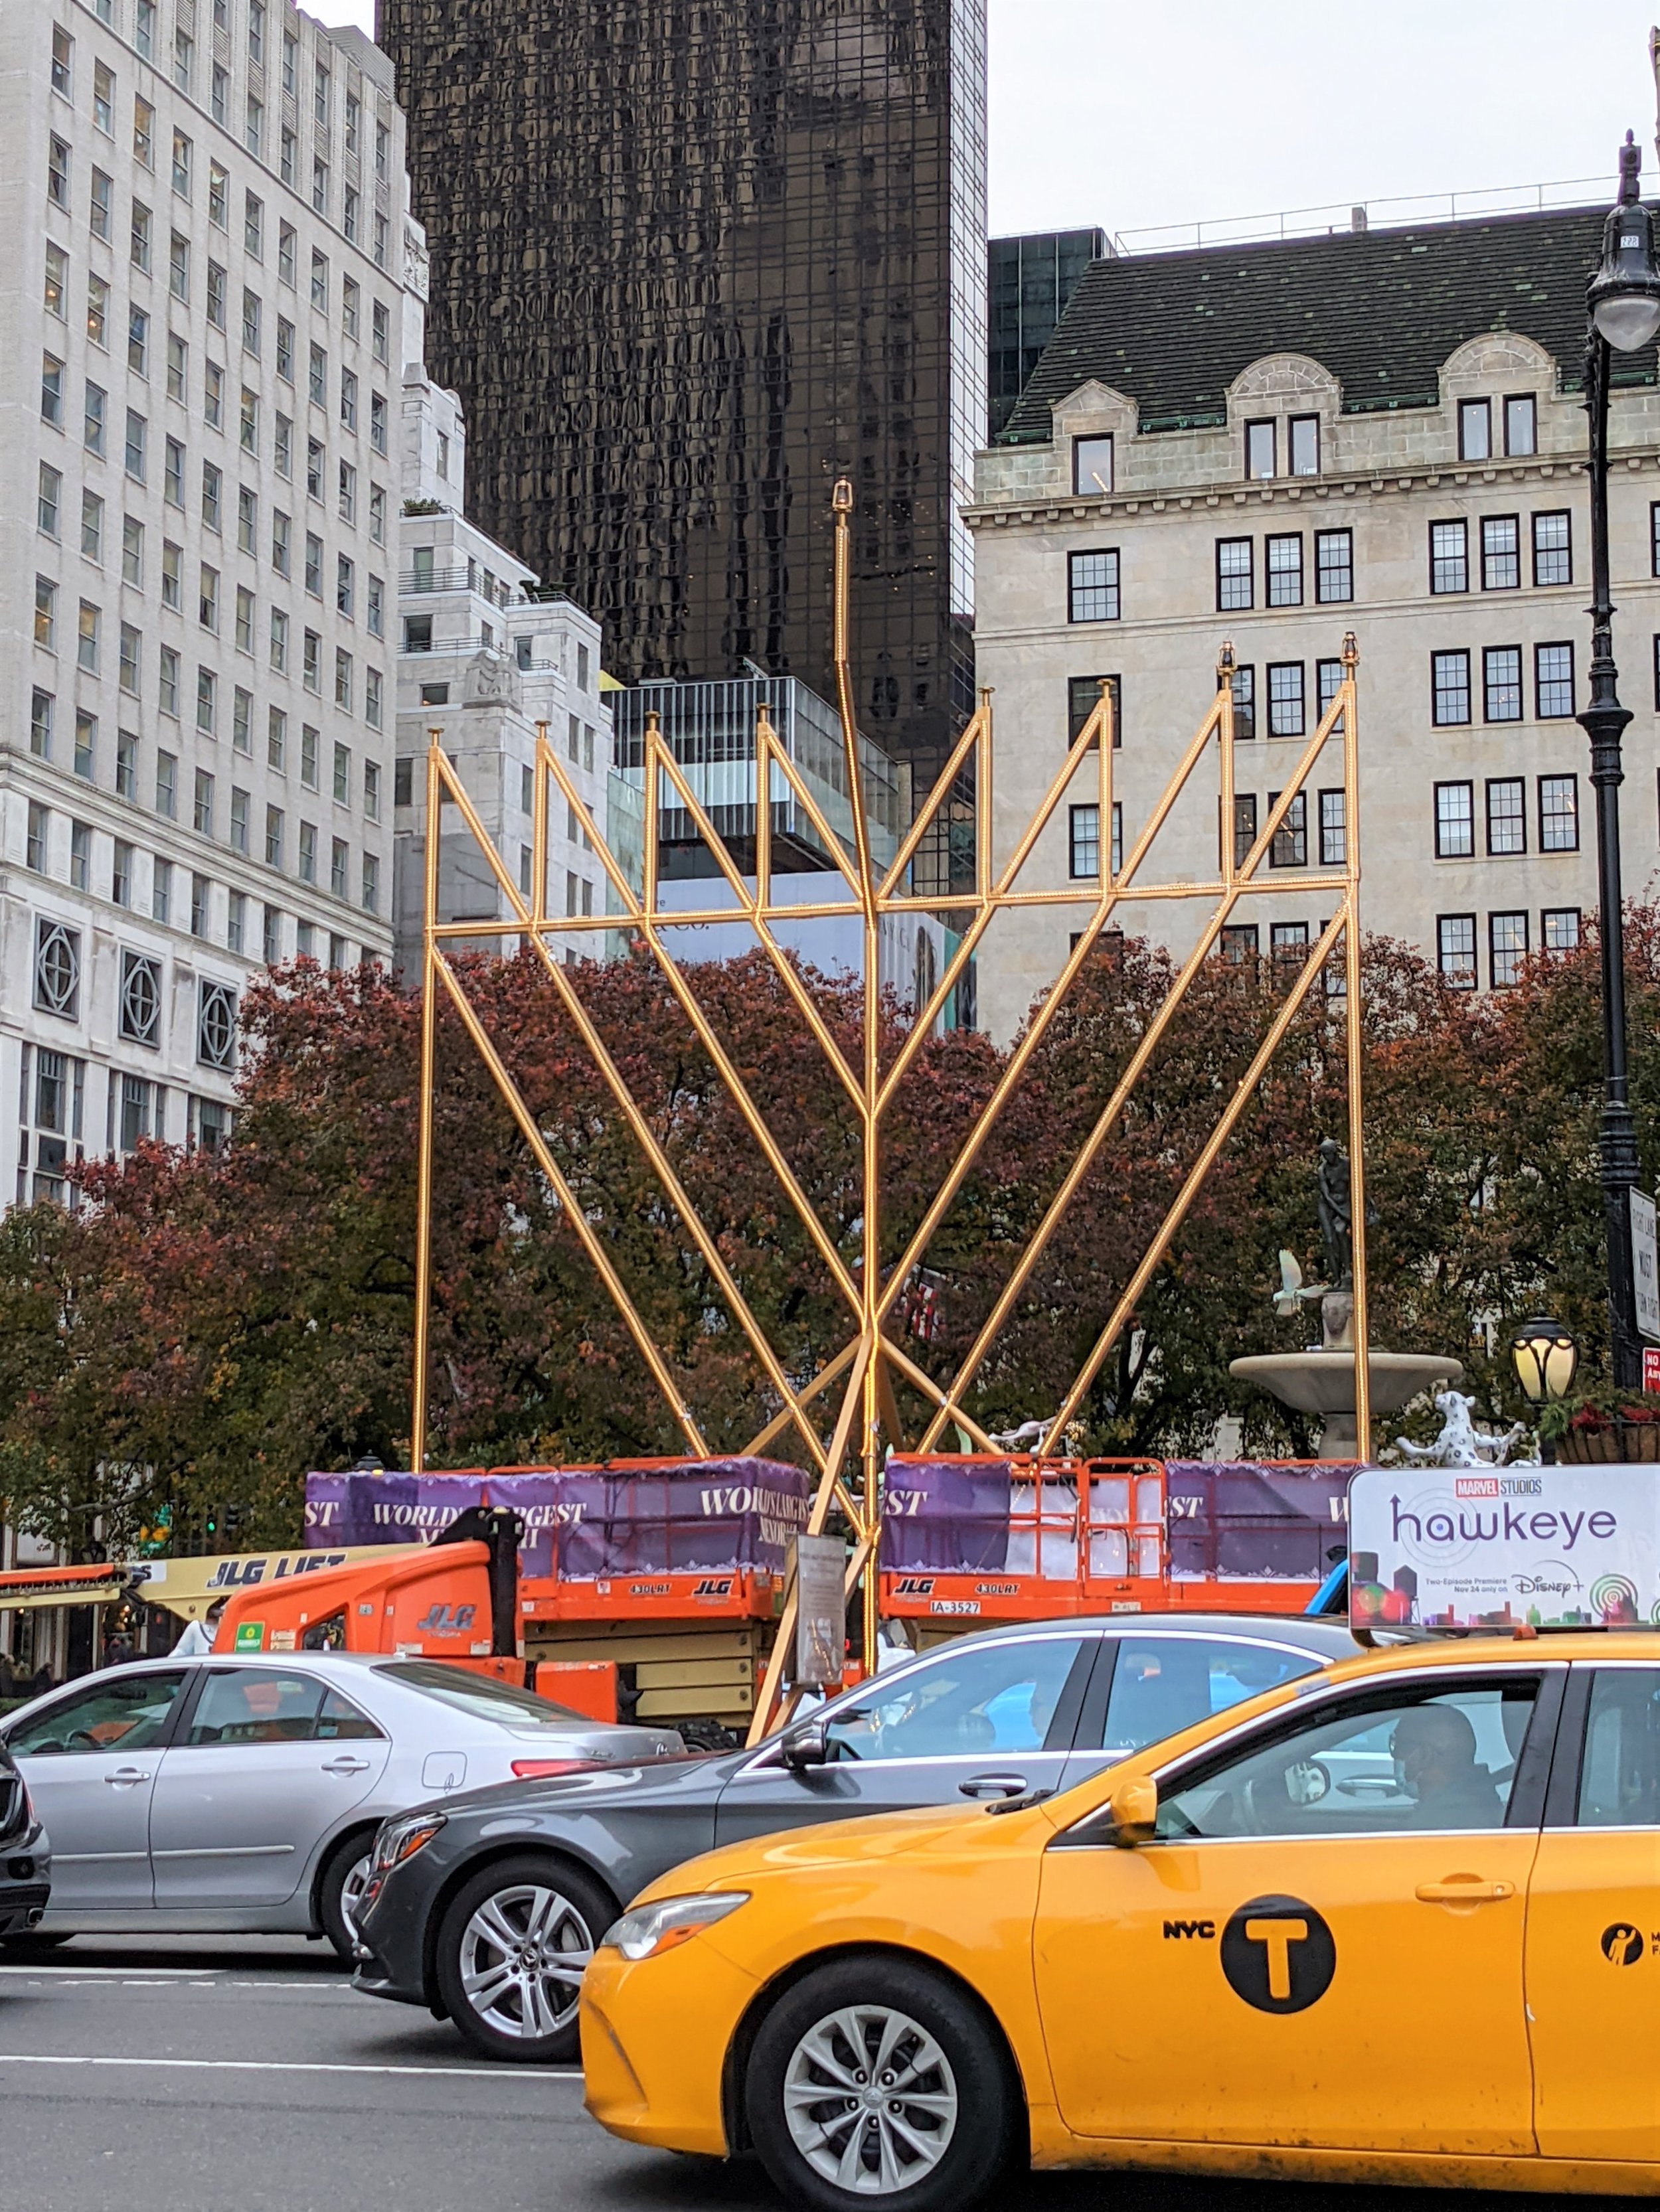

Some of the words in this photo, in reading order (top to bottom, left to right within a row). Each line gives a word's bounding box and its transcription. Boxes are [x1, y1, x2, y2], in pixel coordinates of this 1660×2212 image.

[1647, 1354, 1659, 1366] NO
[1457, 1480, 1497, 1496] MARVEL
[1500, 1479, 1542, 1494] STUDIOS
[884, 1490, 928, 1516] ST
[374, 1503, 464, 1526] WORLD'
[1390, 1494, 1617, 1550] hawkeye
[207, 1559, 268, 1588] JLG
[693, 1579, 732, 1595] JLG
[894, 1578, 935, 1594] JLG
[417, 1603, 477, 1630] JLG
[1163, 1920, 1216, 1939] NYC
